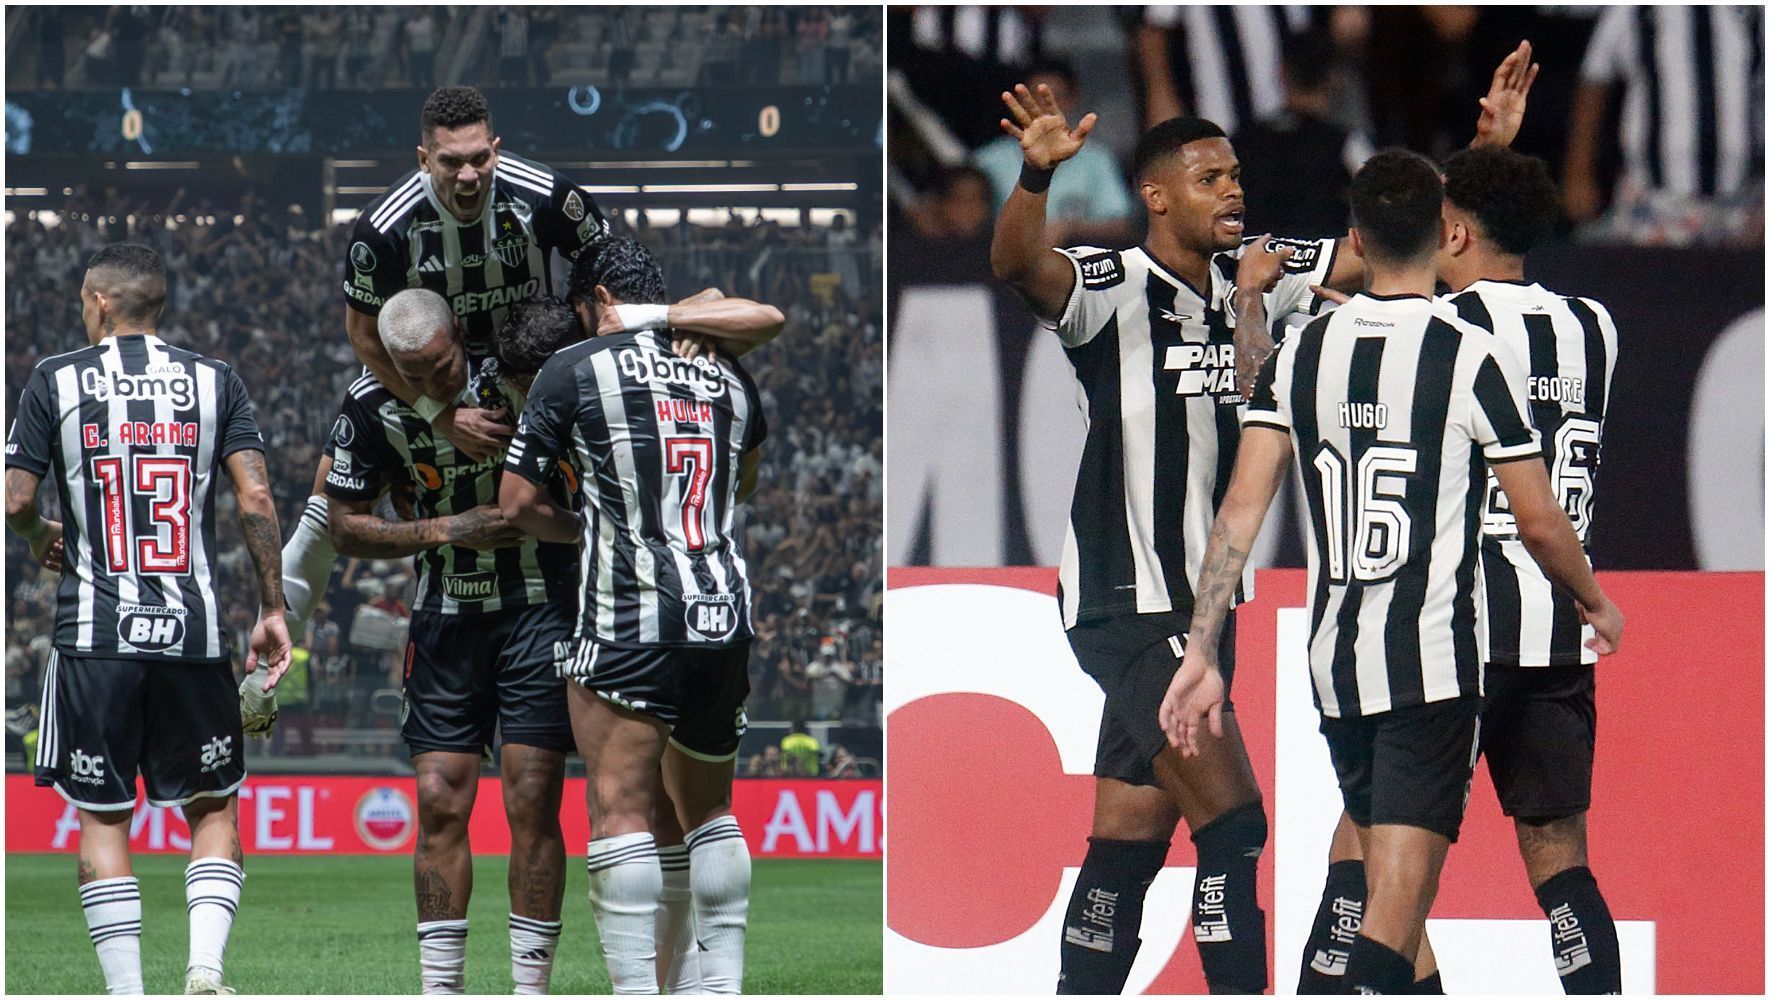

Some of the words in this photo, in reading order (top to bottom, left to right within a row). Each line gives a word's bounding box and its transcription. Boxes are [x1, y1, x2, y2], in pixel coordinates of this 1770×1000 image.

[453, 278, 539, 316] BETANO
[149, 365, 182, 374] GALO
[1165, 344, 1236, 370] PAR
[113, 371, 191, 408] bmg
[1526, 375, 1583, 404] EGORE
[656, 399, 713, 424] HULK
[1338, 401, 1388, 430] HUGO
[119, 421, 198, 447] ARANA
[326, 470, 366, 491] ERDAU
[662, 434, 717, 552] 7
[91, 454, 193, 576] 13
[1313, 446, 1418, 581] 16
[444, 577, 493, 596] Vilma
[116, 605, 188, 616] SUPERMERCADOS
[696, 605, 729, 633] BH
[128, 617, 177, 645] BH
[761, 789, 882, 853] AM
